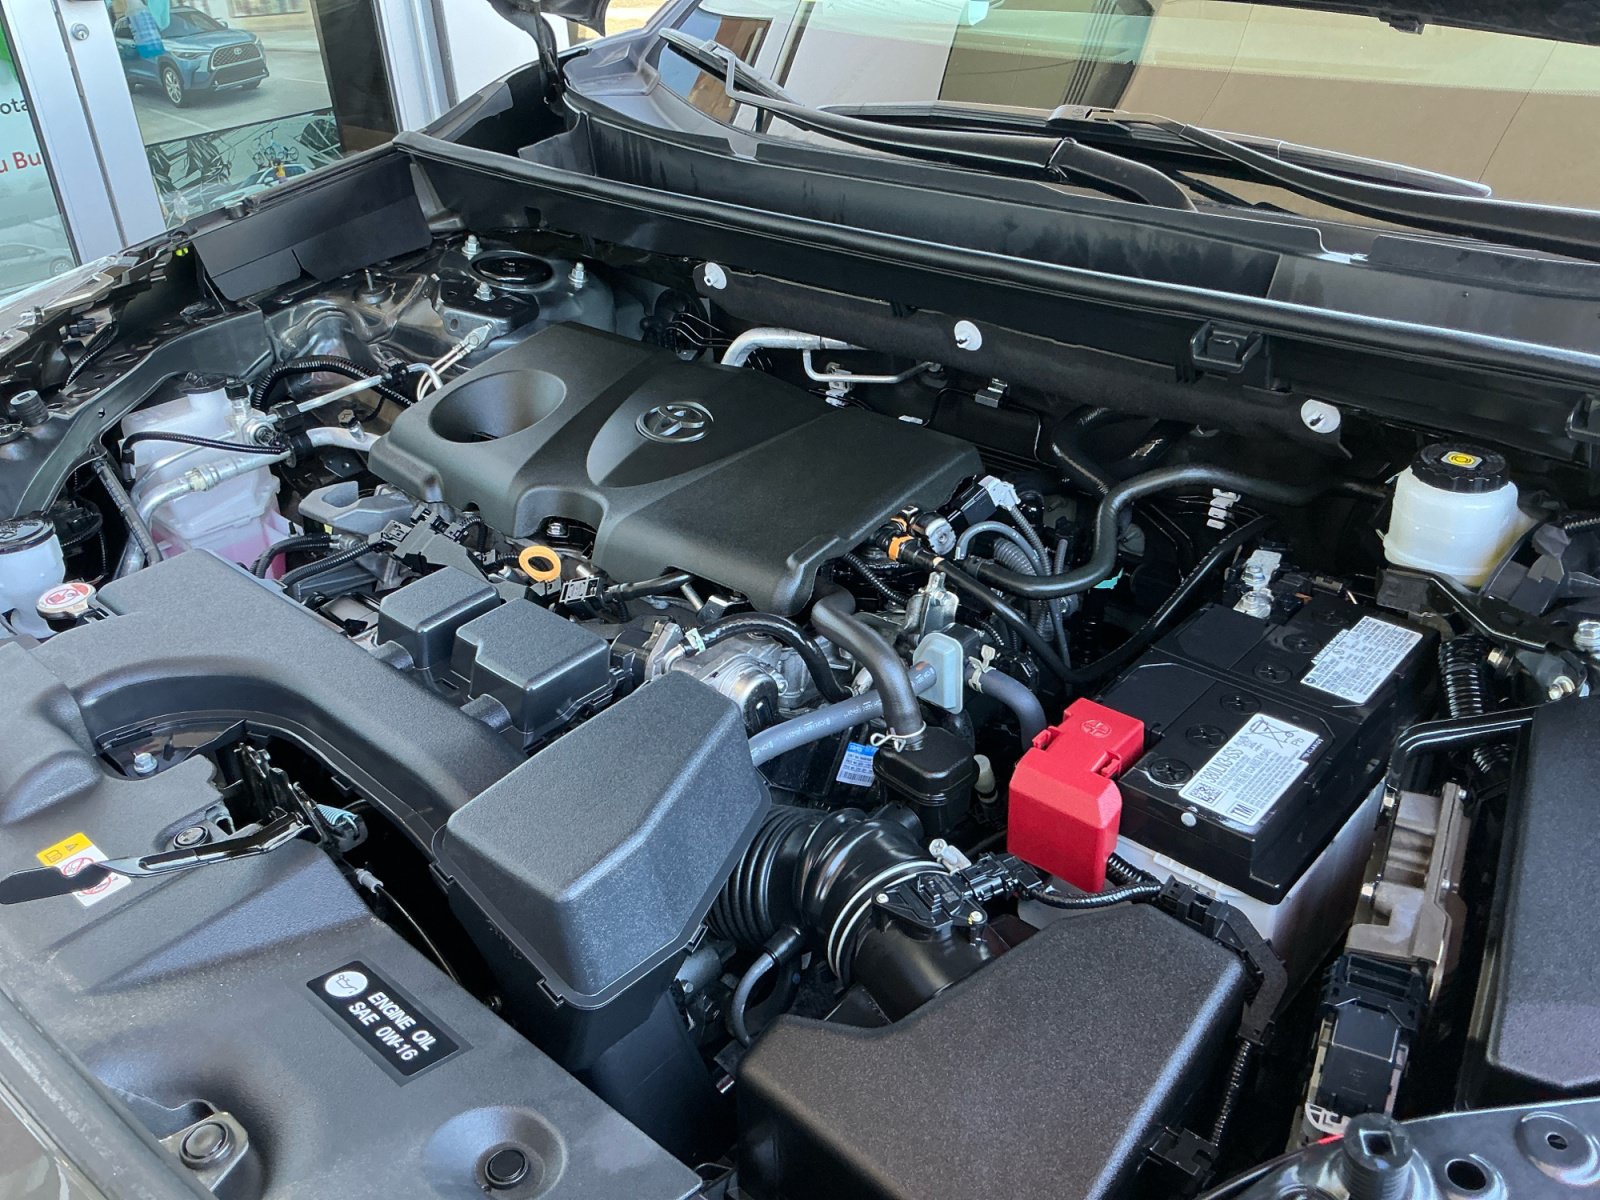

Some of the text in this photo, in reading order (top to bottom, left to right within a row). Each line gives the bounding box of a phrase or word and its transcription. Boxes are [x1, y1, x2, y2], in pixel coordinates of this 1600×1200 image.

[12, 151, 42, 170] Bu
[348, 1001, 419, 1061] SAE 0W-16
[367, 991, 437, 1052] ENGINE OIL
